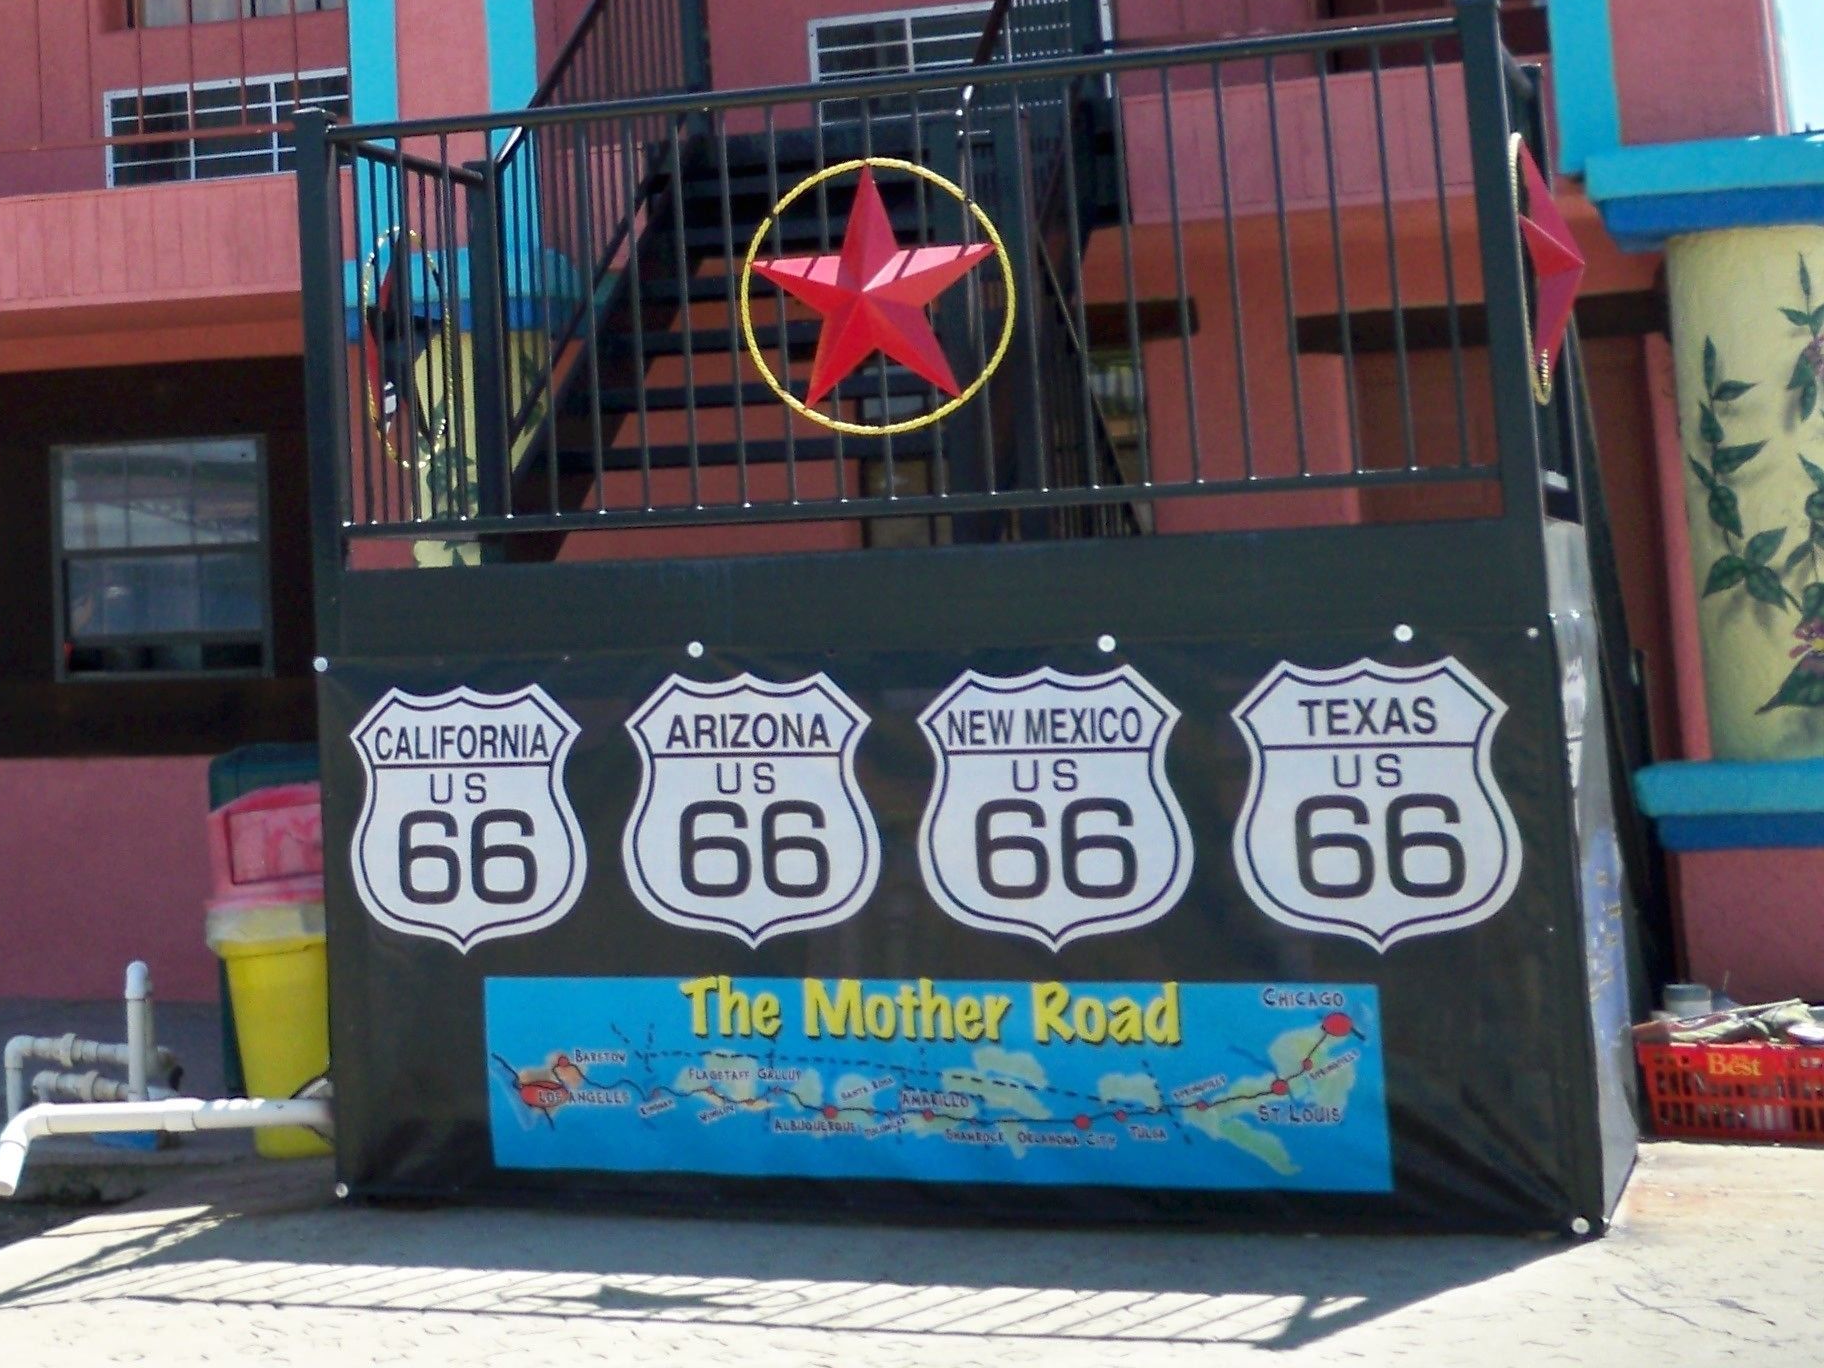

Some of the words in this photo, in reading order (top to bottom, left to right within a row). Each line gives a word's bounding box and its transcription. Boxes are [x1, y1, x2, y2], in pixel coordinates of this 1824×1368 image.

[665, 712, 832, 750] ARIZONA
[946, 709, 1014, 746] NEW
[1024, 706, 1144, 745] MEXICO
[1298, 697, 1439, 736] TEXAS
[375, 723, 550, 761] CALIFORNIA
[428, 772, 488, 804] US
[714, 762, 777, 794] US
[1011, 759, 1080, 793] US
[1331, 752, 1404, 789] US
[398, 808, 539, 905] 66
[679, 798, 832, 899] 66
[975, 796, 1138, 900] 66
[1295, 792, 1468, 900] 66
[680, 974, 782, 1038] The
[802, 976, 1013, 1044] Mother
[1031, 980, 1182, 1047] Road
[1263, 987, 1344, 1007] CHICAGO
[1289, 1105, 1342, 1123] LOUIS
